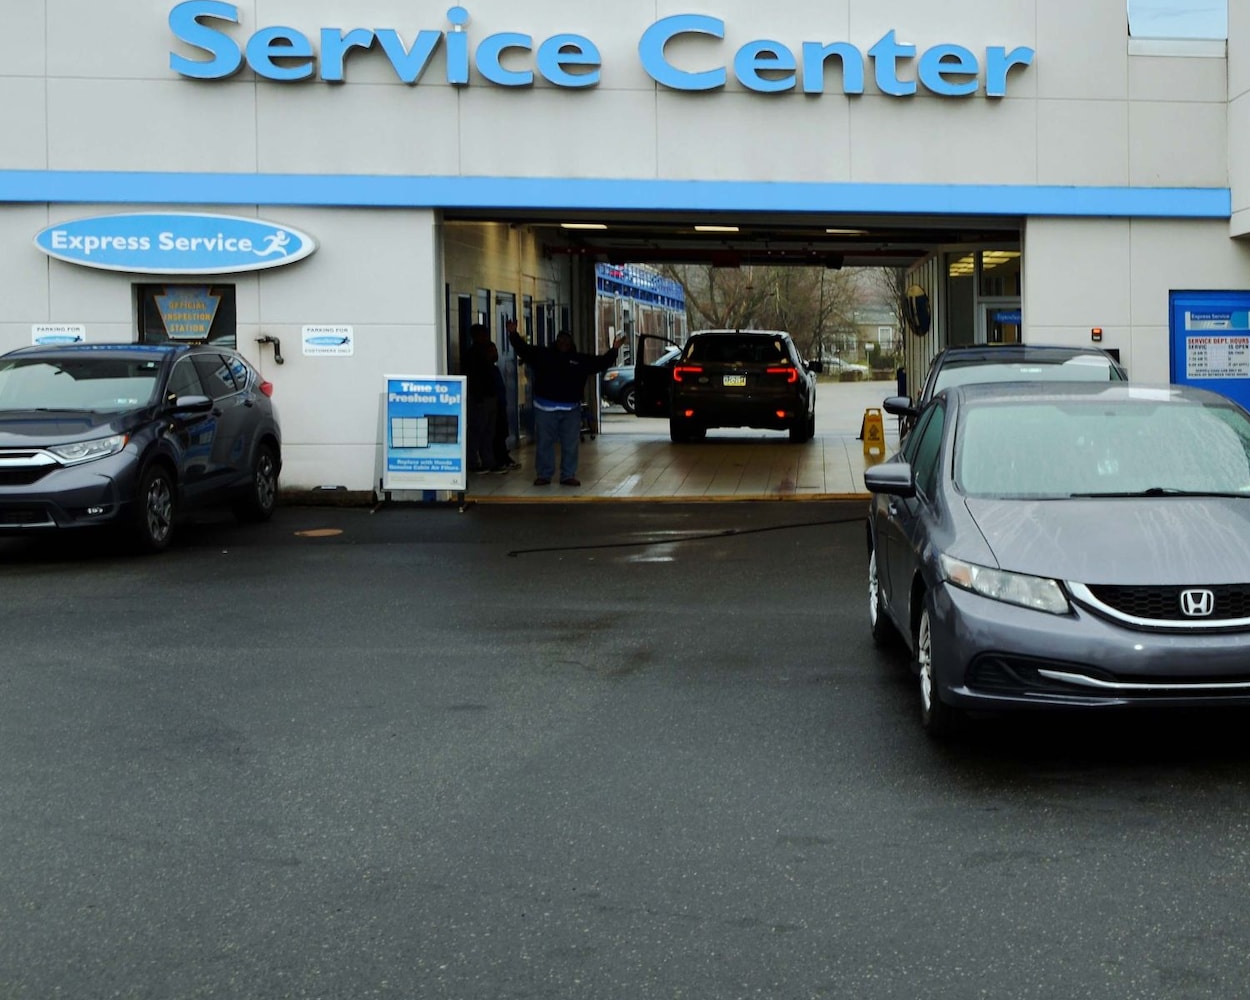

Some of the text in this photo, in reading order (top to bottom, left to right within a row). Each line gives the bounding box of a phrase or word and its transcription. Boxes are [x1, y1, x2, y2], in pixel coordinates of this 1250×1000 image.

[168, 0, 1036, 100] Service Center
[51, 230, 253, 254] Express Service
[170, 324, 205, 332] STATION
[401, 382, 448, 393] Time to
[389, 392, 461, 405] Freshen Up!
